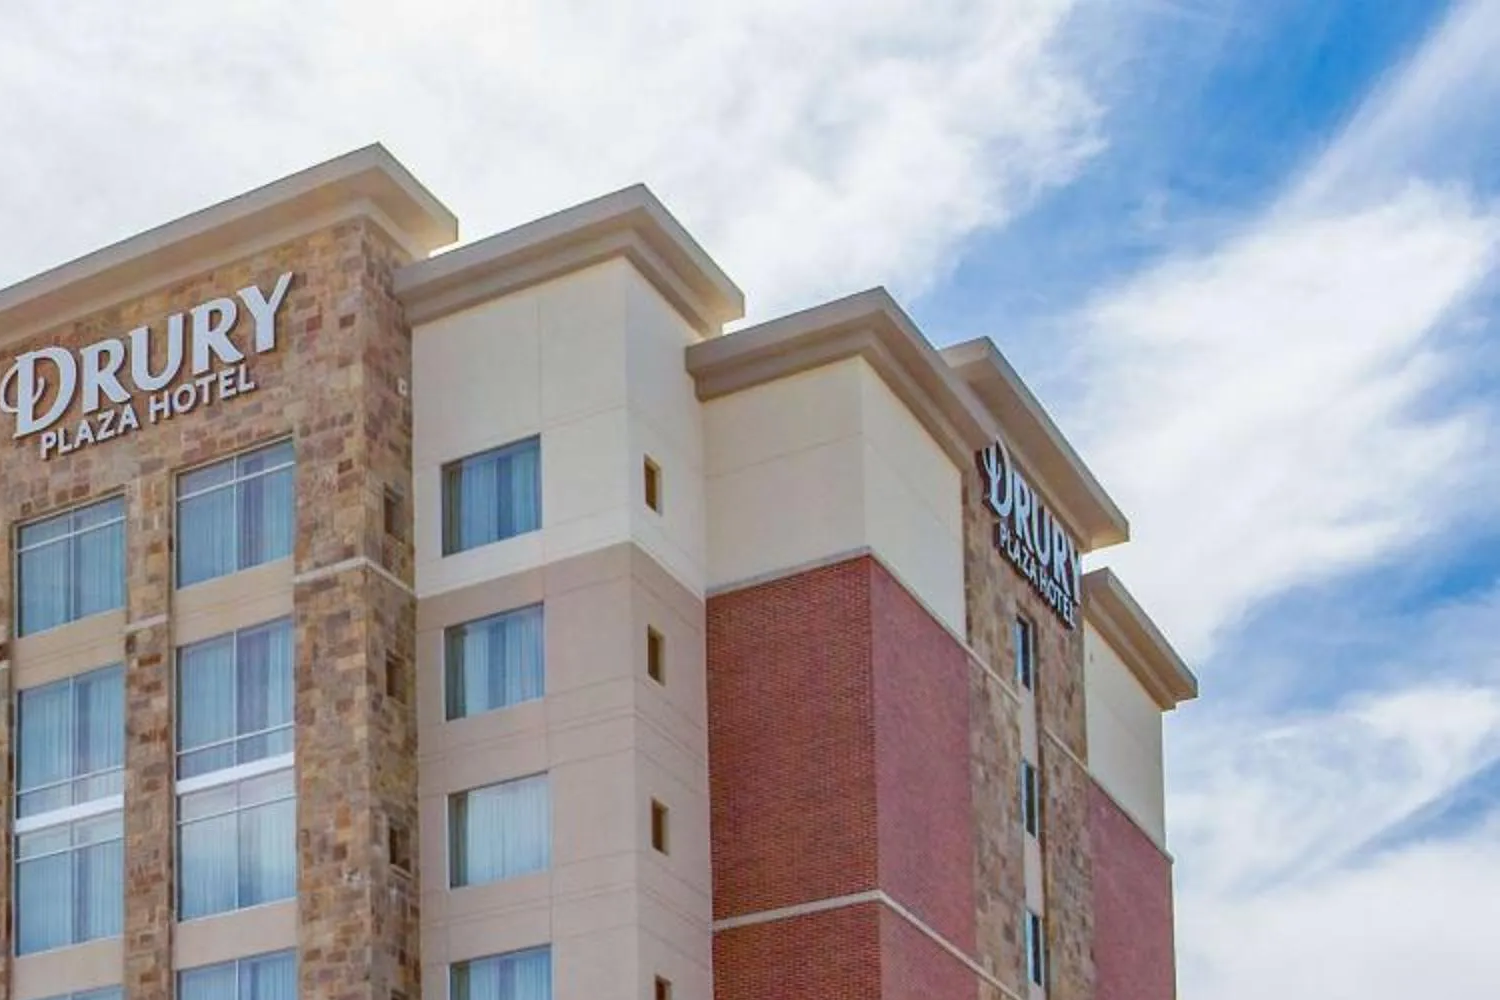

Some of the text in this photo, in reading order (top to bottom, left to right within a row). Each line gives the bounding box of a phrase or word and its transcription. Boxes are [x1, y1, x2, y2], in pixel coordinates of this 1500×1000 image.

[40, 363, 256, 459] PLAZA HOTEL
[982, 436, 1082, 606] DRURY
[999, 520, 1076, 629] PLAZA HOTEL
